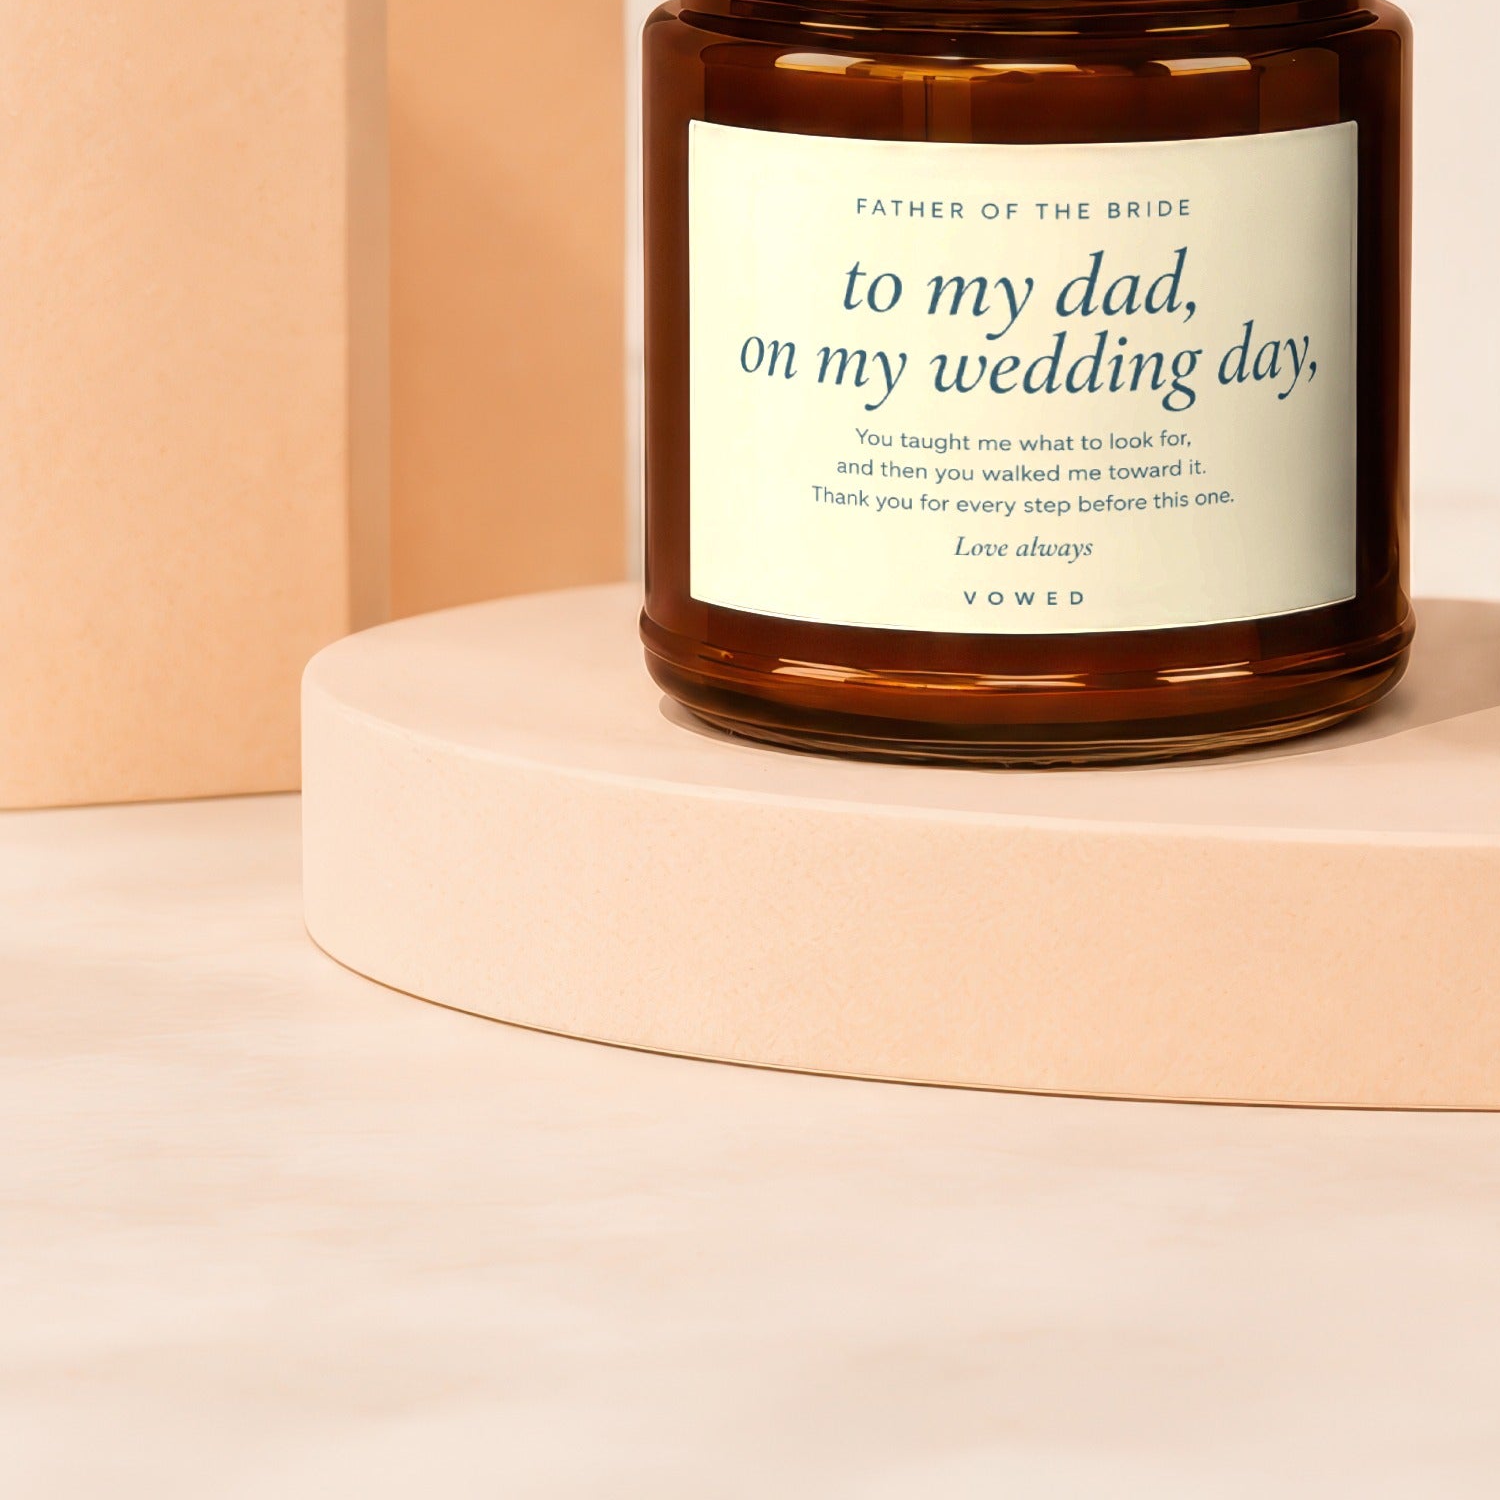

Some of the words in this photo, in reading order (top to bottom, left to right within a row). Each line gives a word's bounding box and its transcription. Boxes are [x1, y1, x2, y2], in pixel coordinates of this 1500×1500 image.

[856, 197, 964, 219] FATHER
[980, 202, 1019, 220] OF
[1035, 202, 1090, 220] THE
[1107, 198, 1190, 220] BRIDE
[843, 260, 903, 313] to
[926, 275, 1035, 341] my
[1055, 245, 1197, 324] dad,
[740, 335, 798, 380] on
[816, 346, 908, 412] my
[929, 329, 1204, 413] wedding
[1217, 318, 1317, 401] day,
[855, 427, 893, 447] You
[900, 432, 971, 455] taught
[978, 438, 1012, 452] me
[1018, 434, 1075, 452] what
[1080, 435, 1103, 451] to
[1109, 431, 1154, 450] look
[1159, 429, 1192, 448] for,
[836, 458, 874, 476] and
[880, 460, 928, 480] then
[934, 467, 974, 485] you
[981, 464, 1060, 482] walked
[1068, 468, 1102, 481] me
[1108, 459, 1182, 481] toward
[1189, 459, 1206, 476] it.
[811, 485, 870, 507] Thank
[875, 495, 913, 513] you
[919, 493, 950, 512] for
[956, 499, 1017, 518] every
[1023, 498, 1072, 517] step
[1078, 494, 1148, 513] before
[1152, 491, 1189, 510] this
[1194, 490, 1235, 507] one.
[954, 535, 1009, 557] Love
[1015, 535, 1094, 565] always
[963, 590, 1084, 606] VOWED
